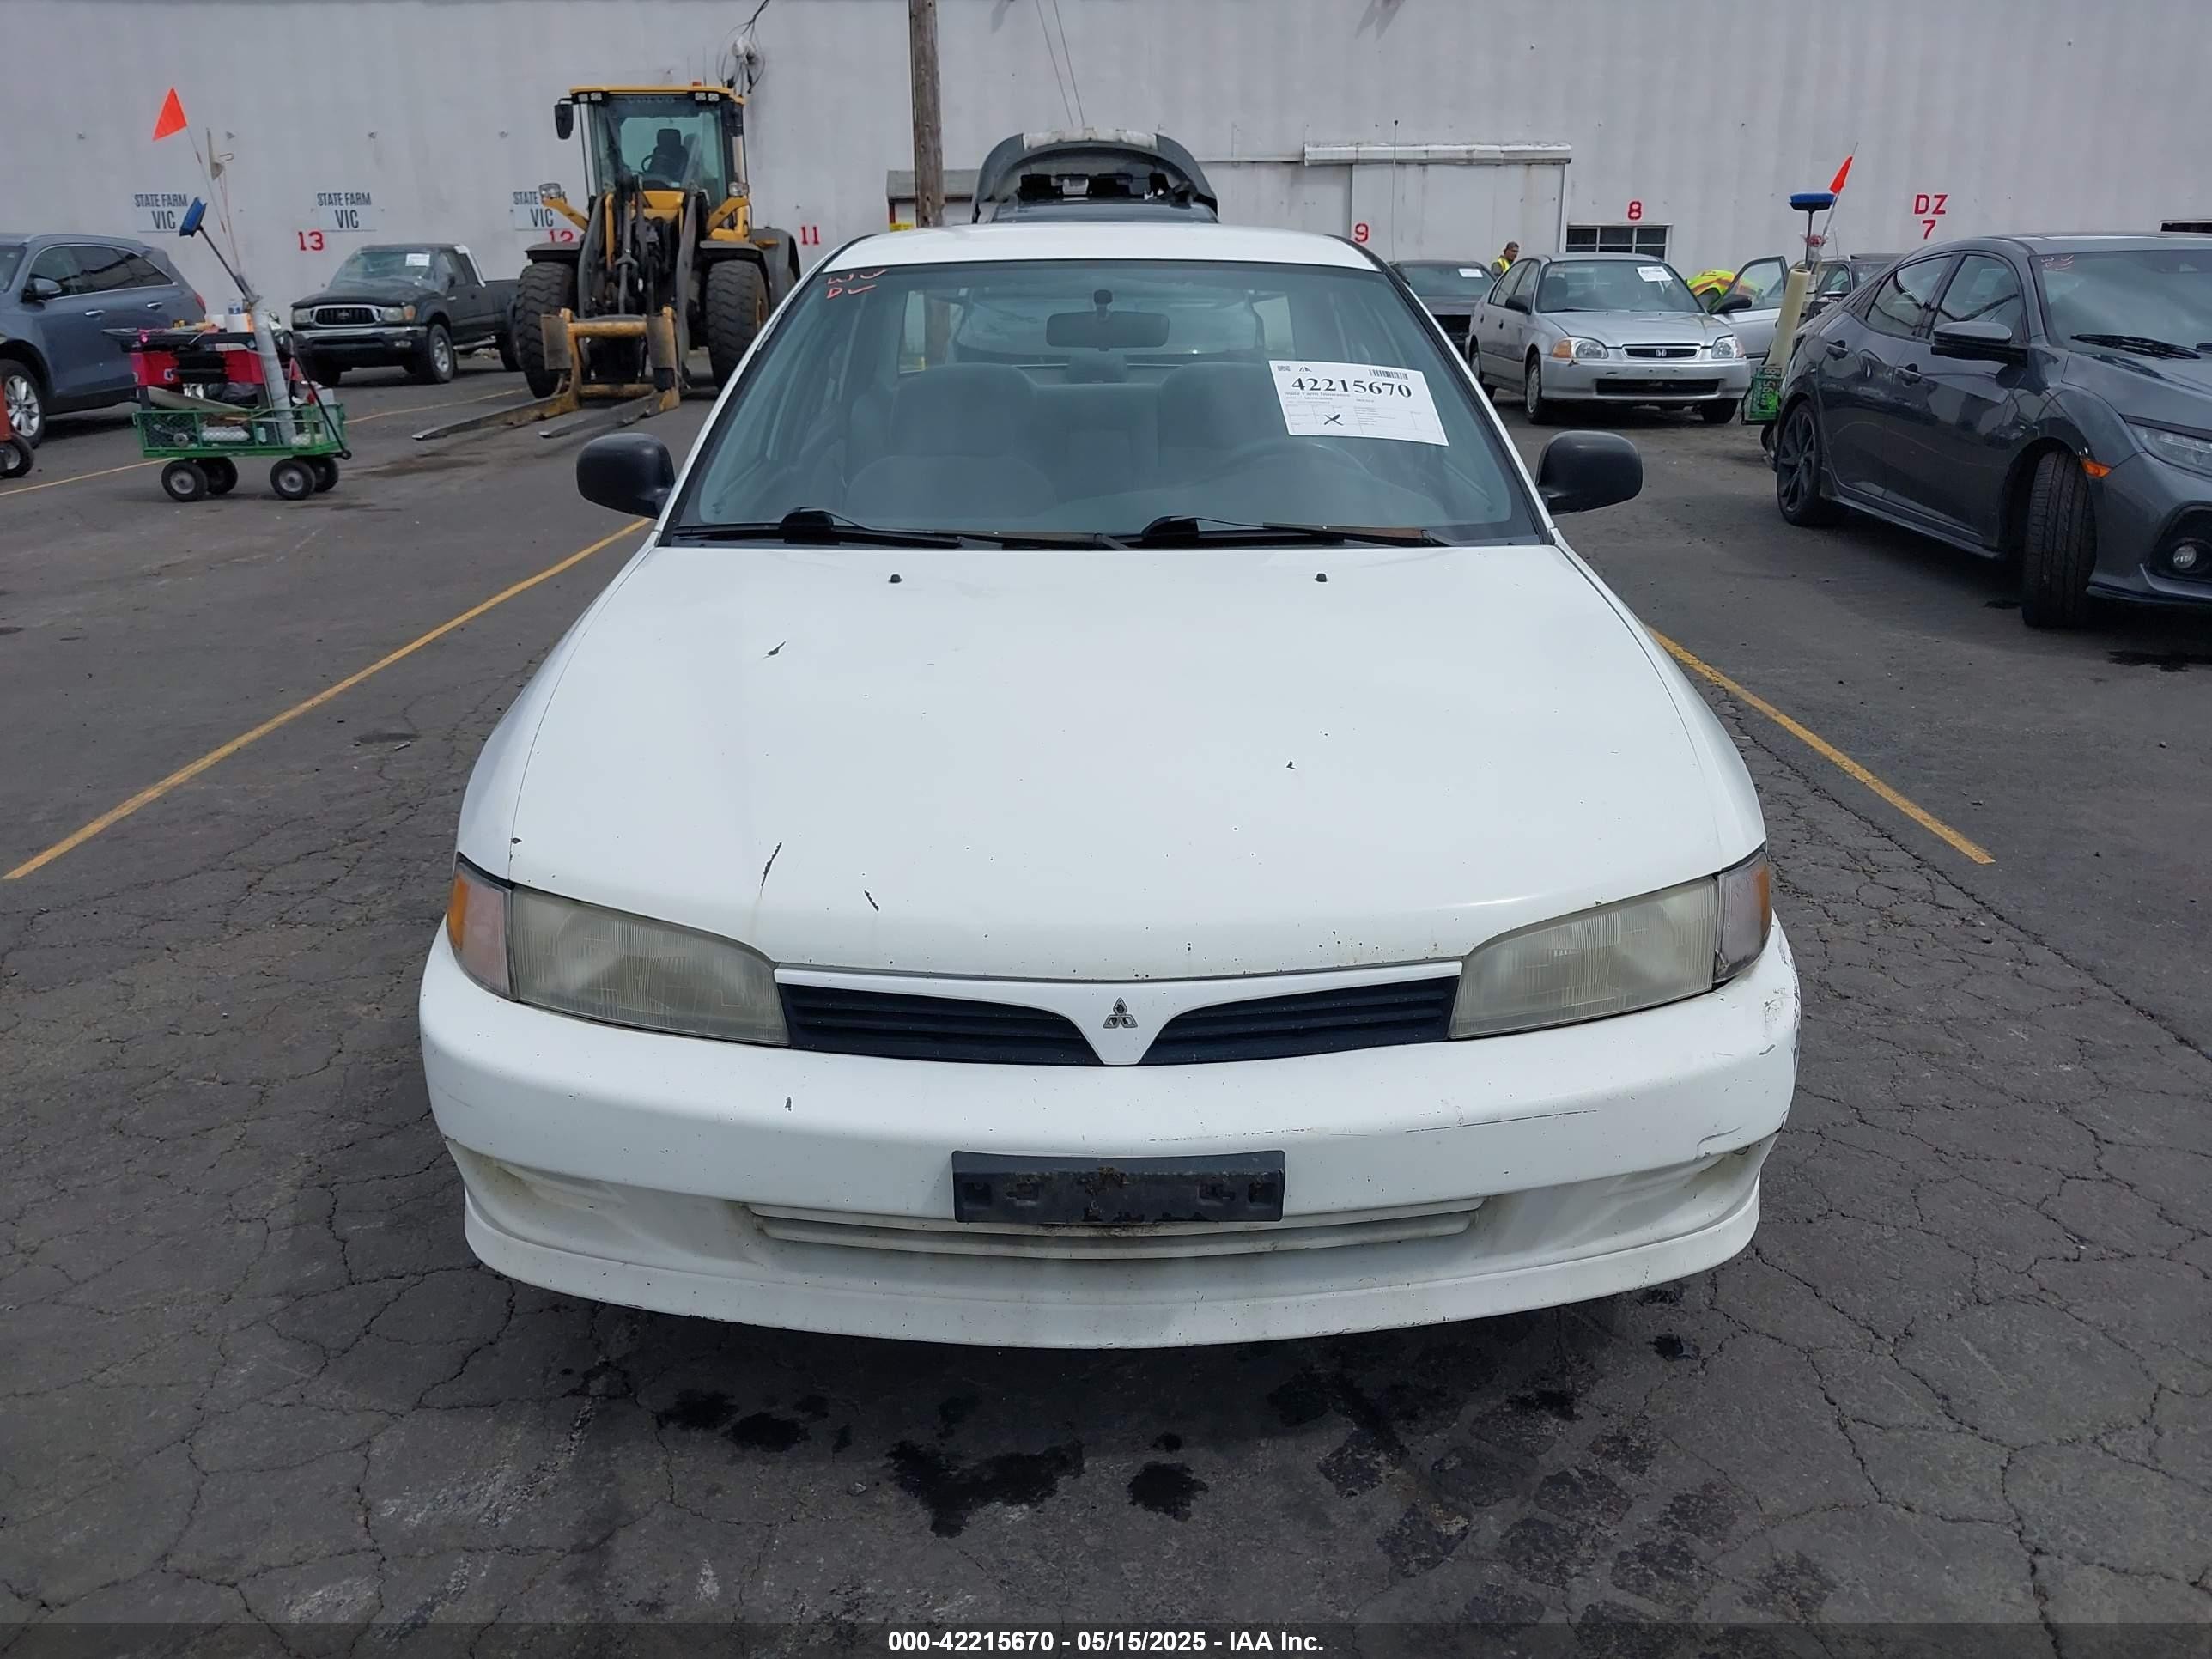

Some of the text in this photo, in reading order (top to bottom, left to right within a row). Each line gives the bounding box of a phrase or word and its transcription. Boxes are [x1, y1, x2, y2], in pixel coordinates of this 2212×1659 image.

[134, 193, 188, 207] STATE FARM
[316, 192, 372, 206] STATE FARM
[514, 191, 538, 205] STATE
[1914, 194, 1948, 215] DZ
[152, 210, 176, 229] VIC
[335, 210, 359, 229] VIC
[530, 209, 554, 228] VIC
[1627, 201, 1642, 220] 8
[800, 226, 819, 245] 11
[1354, 223, 1369, 242] 9
[1922, 220, 1936, 240] 7
[298, 231, 324, 251] 13
[1291, 378, 1413, 398] 42215670
